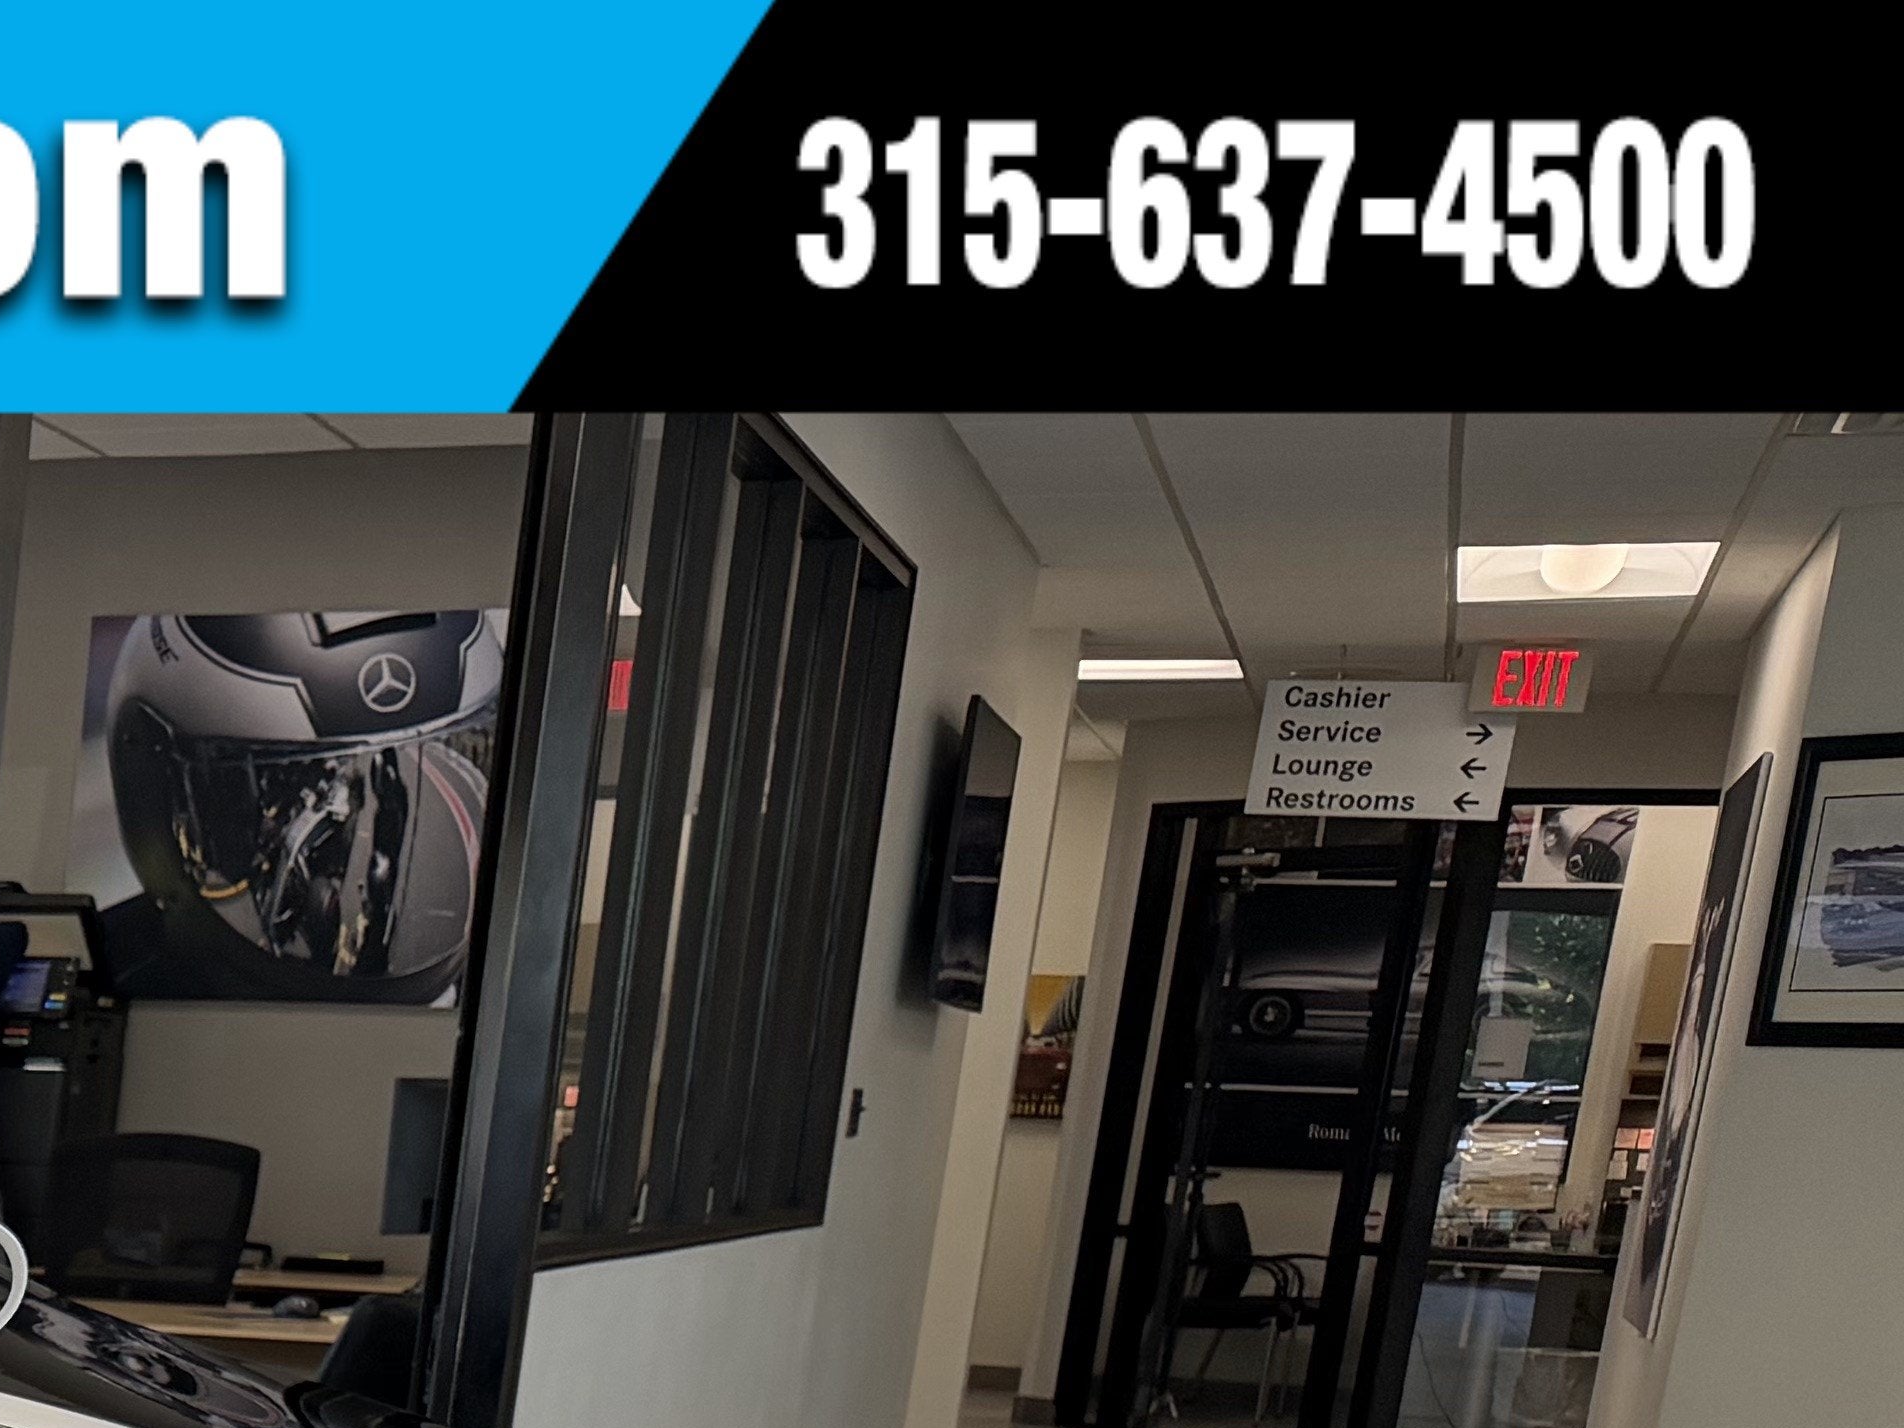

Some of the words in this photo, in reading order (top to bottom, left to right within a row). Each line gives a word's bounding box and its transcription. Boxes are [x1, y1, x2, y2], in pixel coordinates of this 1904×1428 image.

[1492, 650, 1580, 708] EXIT
[1285, 685, 1392, 709] Cashier
[1277, 719, 1381, 744] Service
[1272, 754, 1373, 782] Lounge
[1265, 787, 1415, 812] Restrooms
